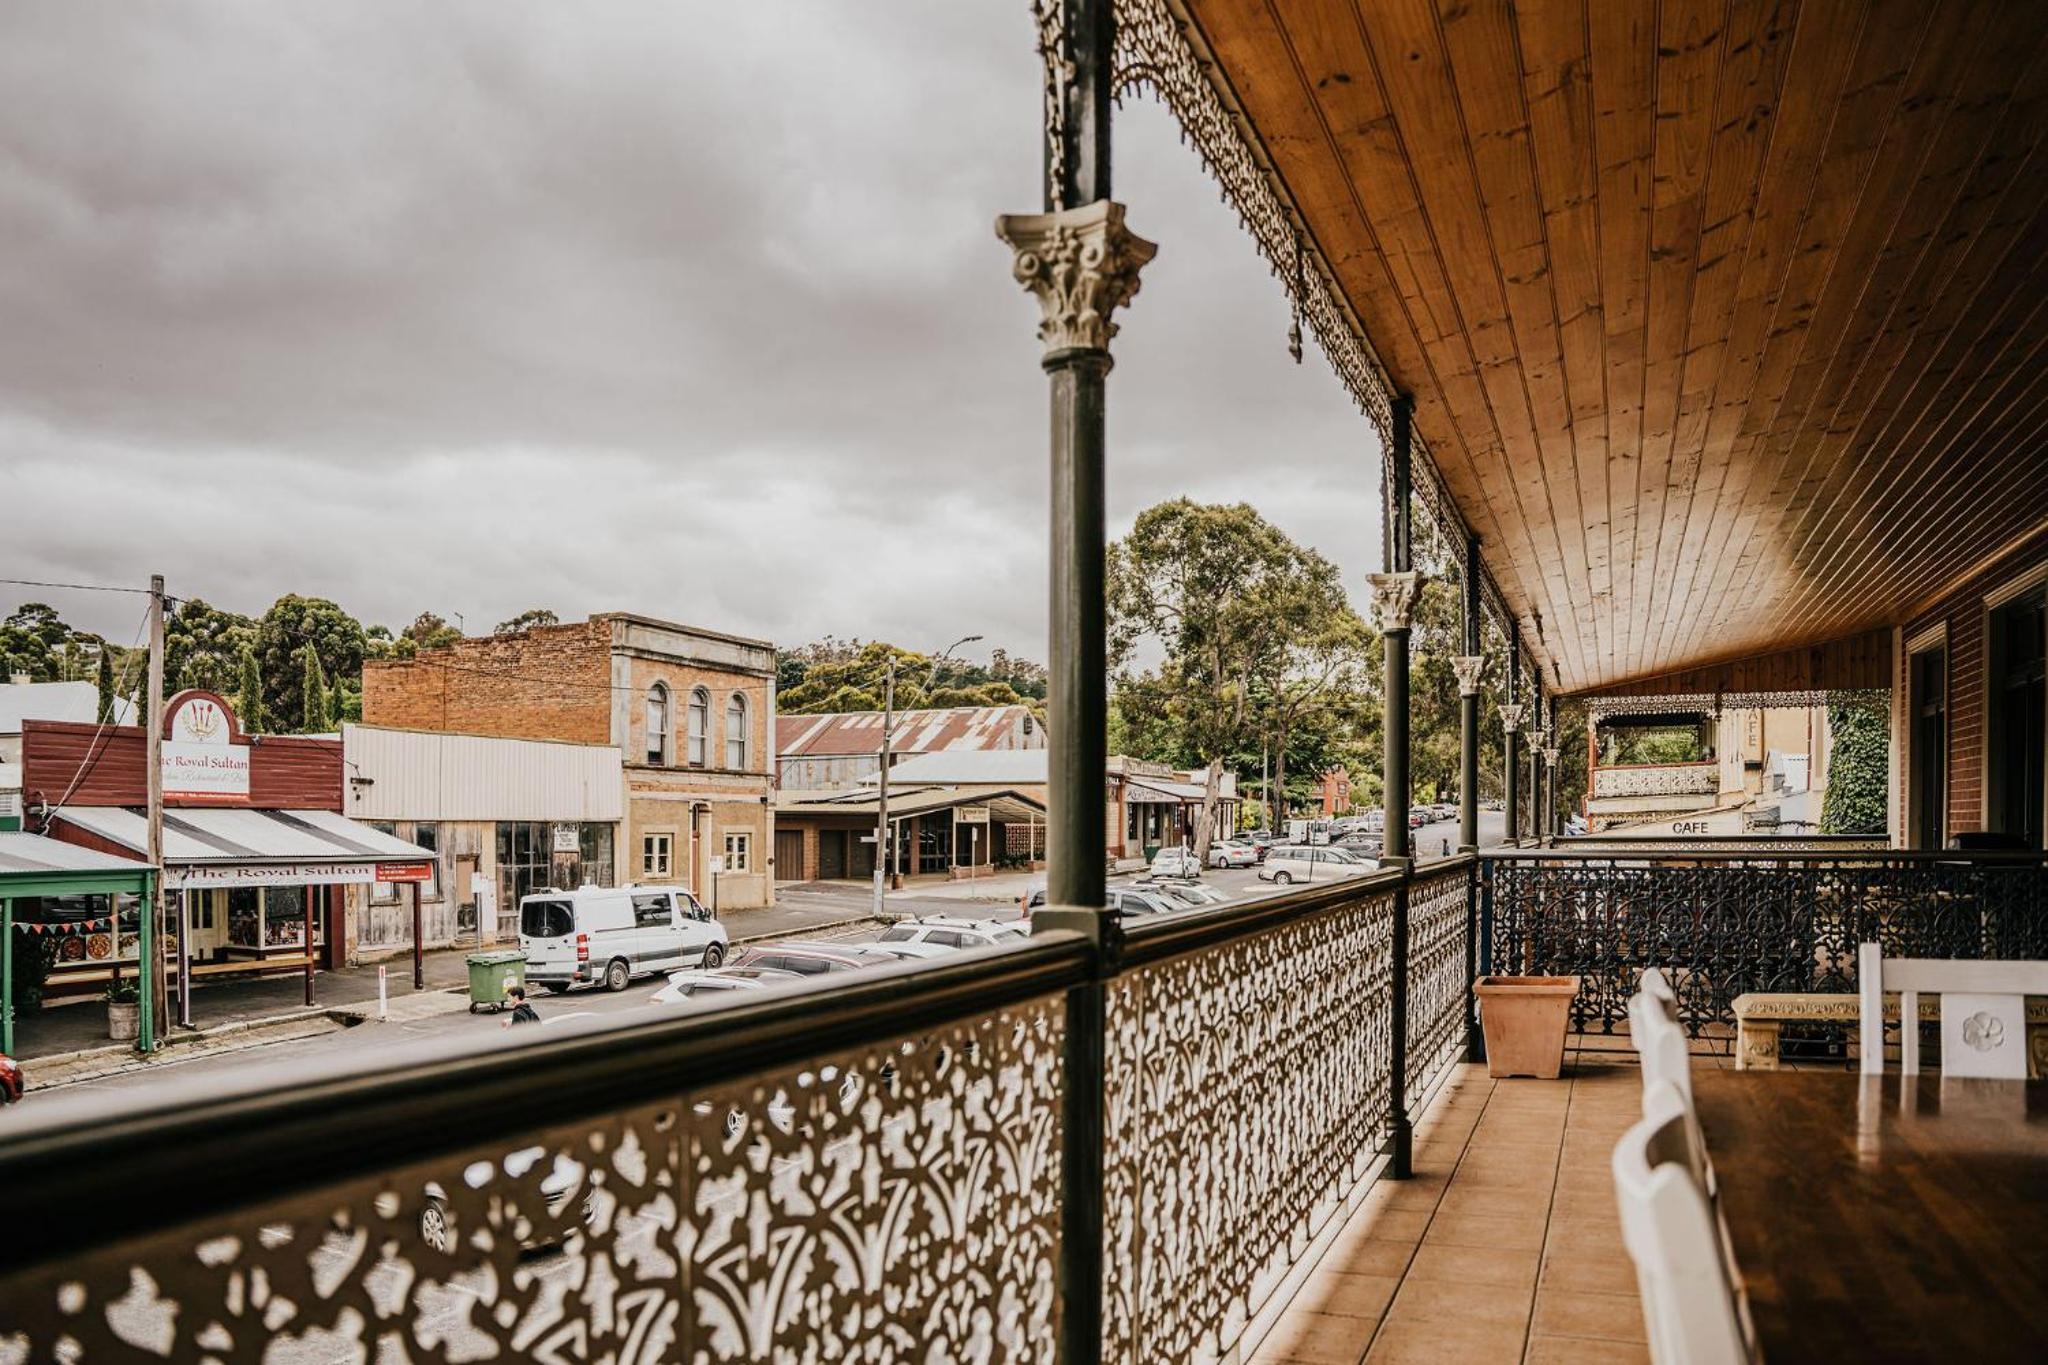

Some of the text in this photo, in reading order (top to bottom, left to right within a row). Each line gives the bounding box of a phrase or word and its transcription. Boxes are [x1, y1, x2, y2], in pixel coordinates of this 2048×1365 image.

[1748, 706, 1758, 746] AFE
[175, 755, 209, 769] Royal
[211, 756, 248, 770] Sultan
[1672, 821, 1709, 834] CAFE
[189, 867, 228, 879] The
[236, 865, 298, 878] Royal
[304, 865, 369, 876] Sultan
